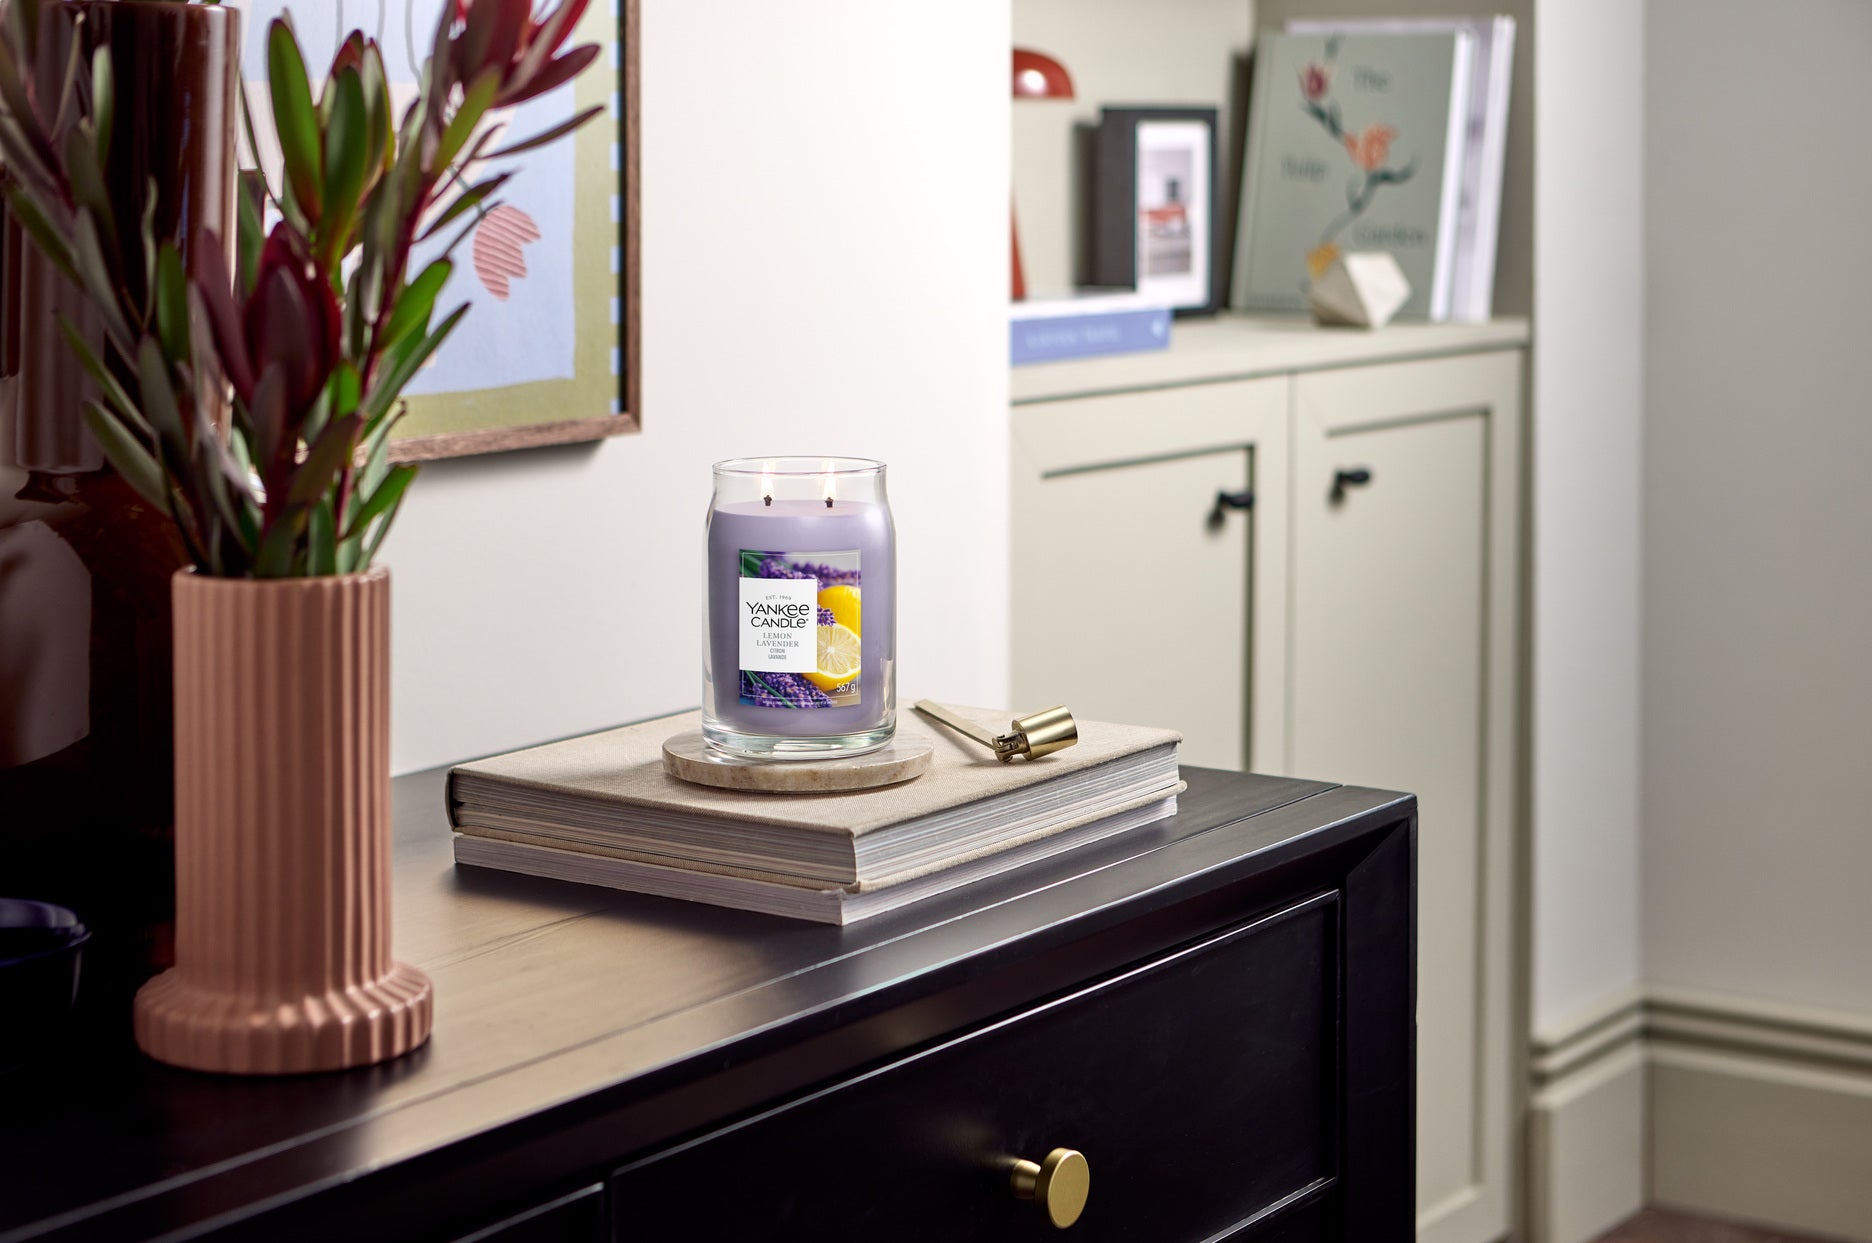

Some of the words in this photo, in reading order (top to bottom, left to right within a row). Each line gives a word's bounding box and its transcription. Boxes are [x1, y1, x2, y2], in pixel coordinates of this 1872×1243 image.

[756, 639, 799, 647] LAVENDER
[836, 682, 849, 692] 567
[850, 683, 855, 693] g
